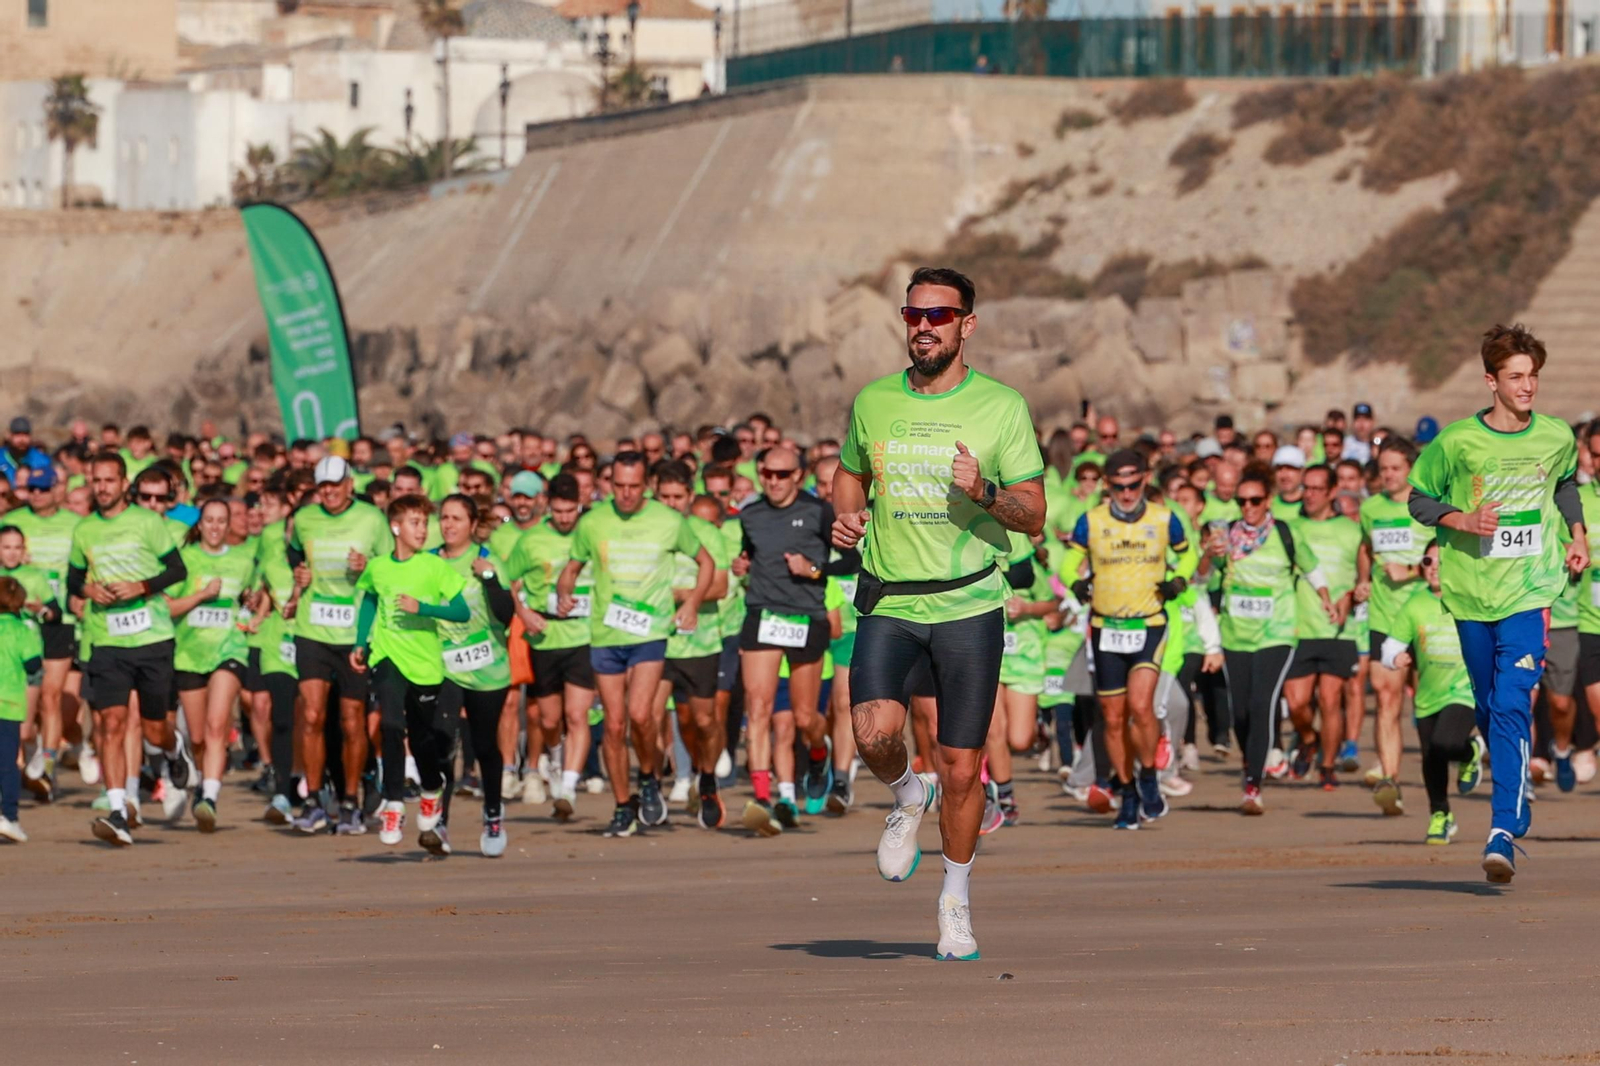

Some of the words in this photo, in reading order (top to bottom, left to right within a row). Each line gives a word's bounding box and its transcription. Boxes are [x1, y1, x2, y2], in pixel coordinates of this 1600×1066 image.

[888, 440, 908, 454] En
[912, 444, 976, 458] marc
[886, 460, 951, 478] contra
[889, 476, 953, 499] cánc
[1379, 531, 1409, 544] 2026
[1501, 529, 1532, 547] 941
[115, 611, 145, 628] 1417
[199, 610, 228, 622] 1713
[319, 607, 351, 620] 1416
[615, 609, 648, 628] 1254
[769, 624, 804, 640] 2030
[1111, 633, 1142, 646] 1715
[455, 644, 489, 664] 4129
